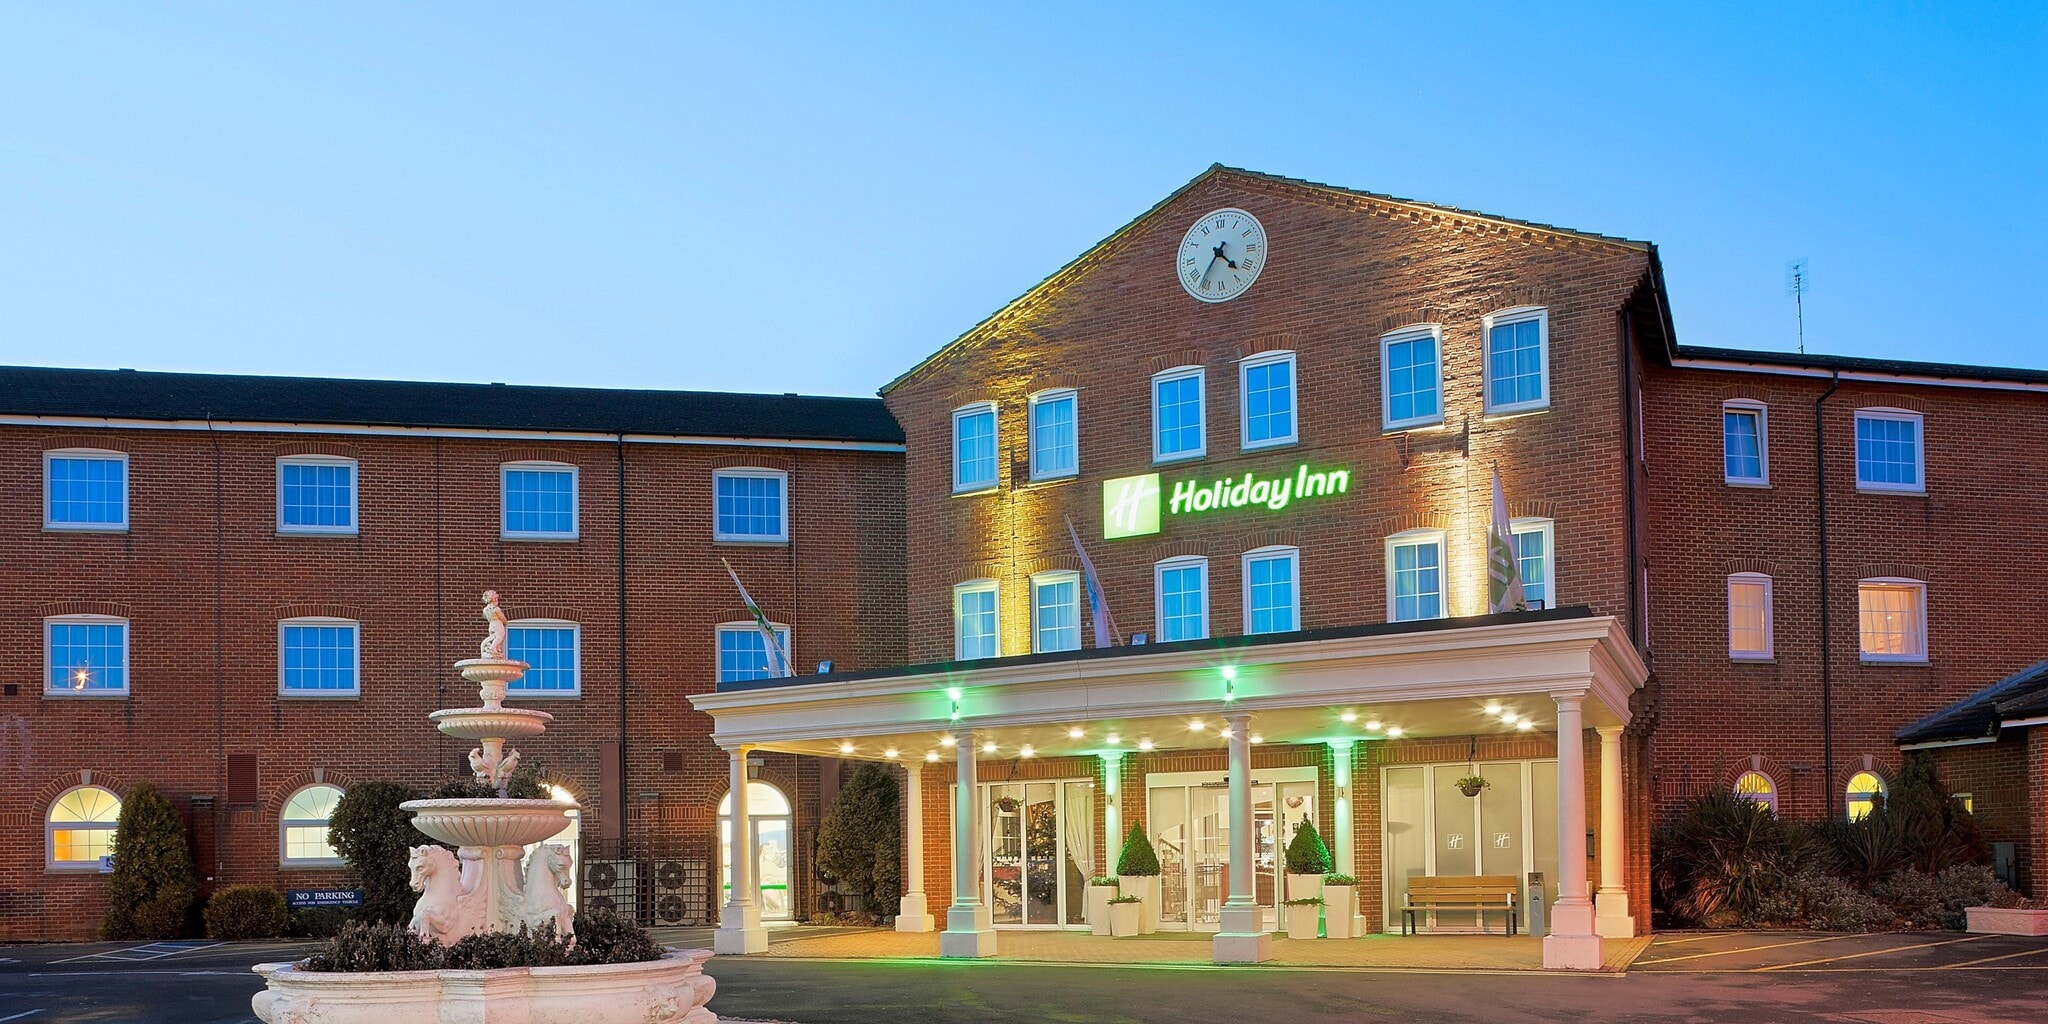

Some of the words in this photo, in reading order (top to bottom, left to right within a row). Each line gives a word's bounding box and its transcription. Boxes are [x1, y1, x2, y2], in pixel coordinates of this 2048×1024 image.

[1215, 219, 1225, 229] XII
[1170, 472, 1292, 515] Holiday
[1295, 464, 1349, 499] Inn
[314, 892, 355, 900] PARKING
